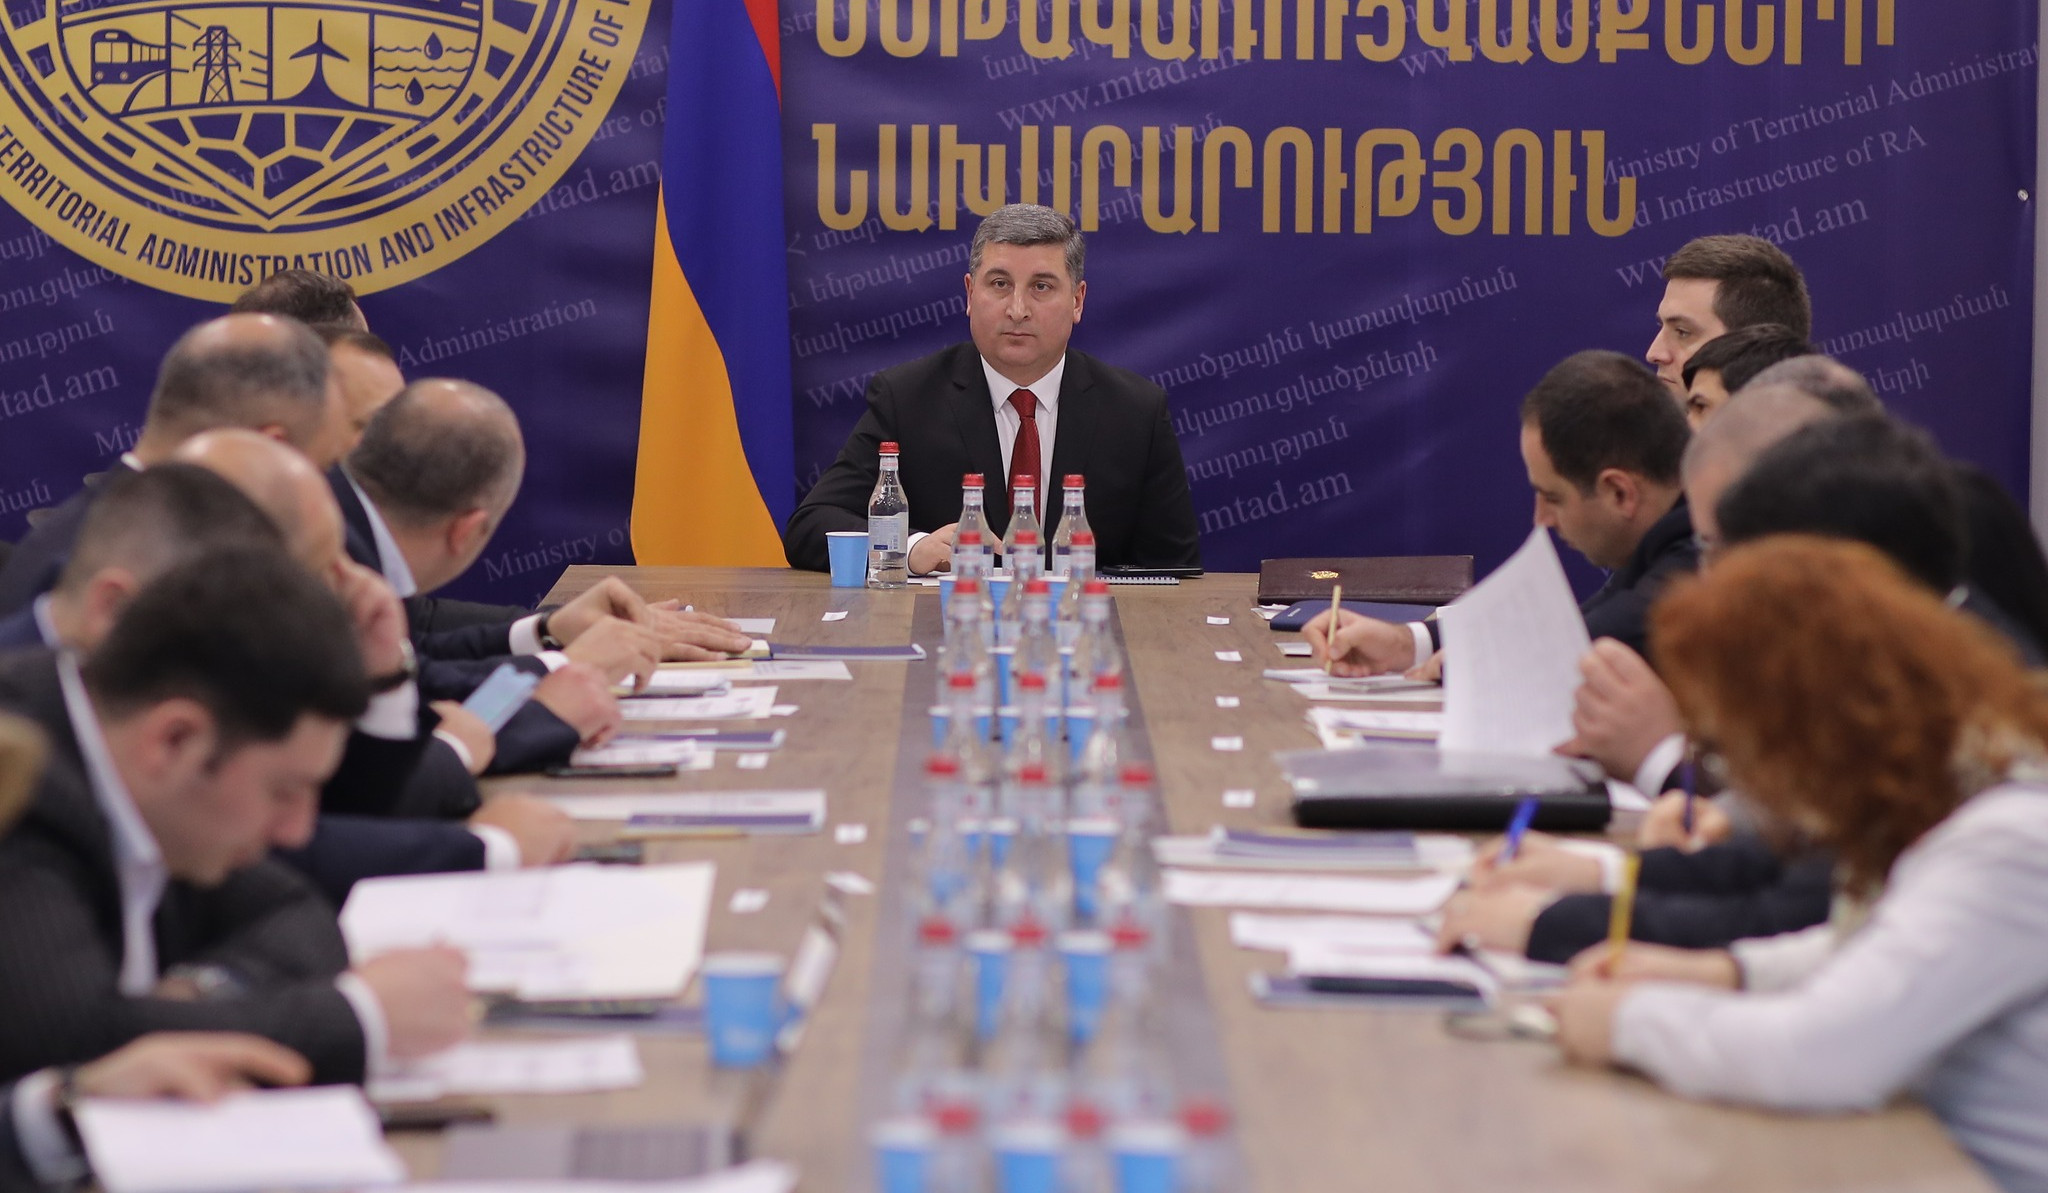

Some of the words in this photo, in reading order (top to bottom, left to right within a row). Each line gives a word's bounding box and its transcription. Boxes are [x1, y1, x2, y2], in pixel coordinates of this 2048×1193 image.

[0, 124, 131, 255] TERRITORIAL
[379, 221, 435, 269] AND
[433, 48, 611, 242] INFRASTRUCTURE
[589, 9, 624, 47] OF
[1711, 123, 1741, 156] of
[1742, 83, 1880, 145] Territorial
[811, 123, 1637, 237] ՆԱԽԱՐԱՐՈՒԹՅՈՒՆ
[1656, 154, 1838, 221] Infrastructure
[1845, 135, 1875, 168] of
[1878, 124, 1928, 157] RA
[396, 297, 598, 370] Administration
[484, 533, 601, 582] Ministry
